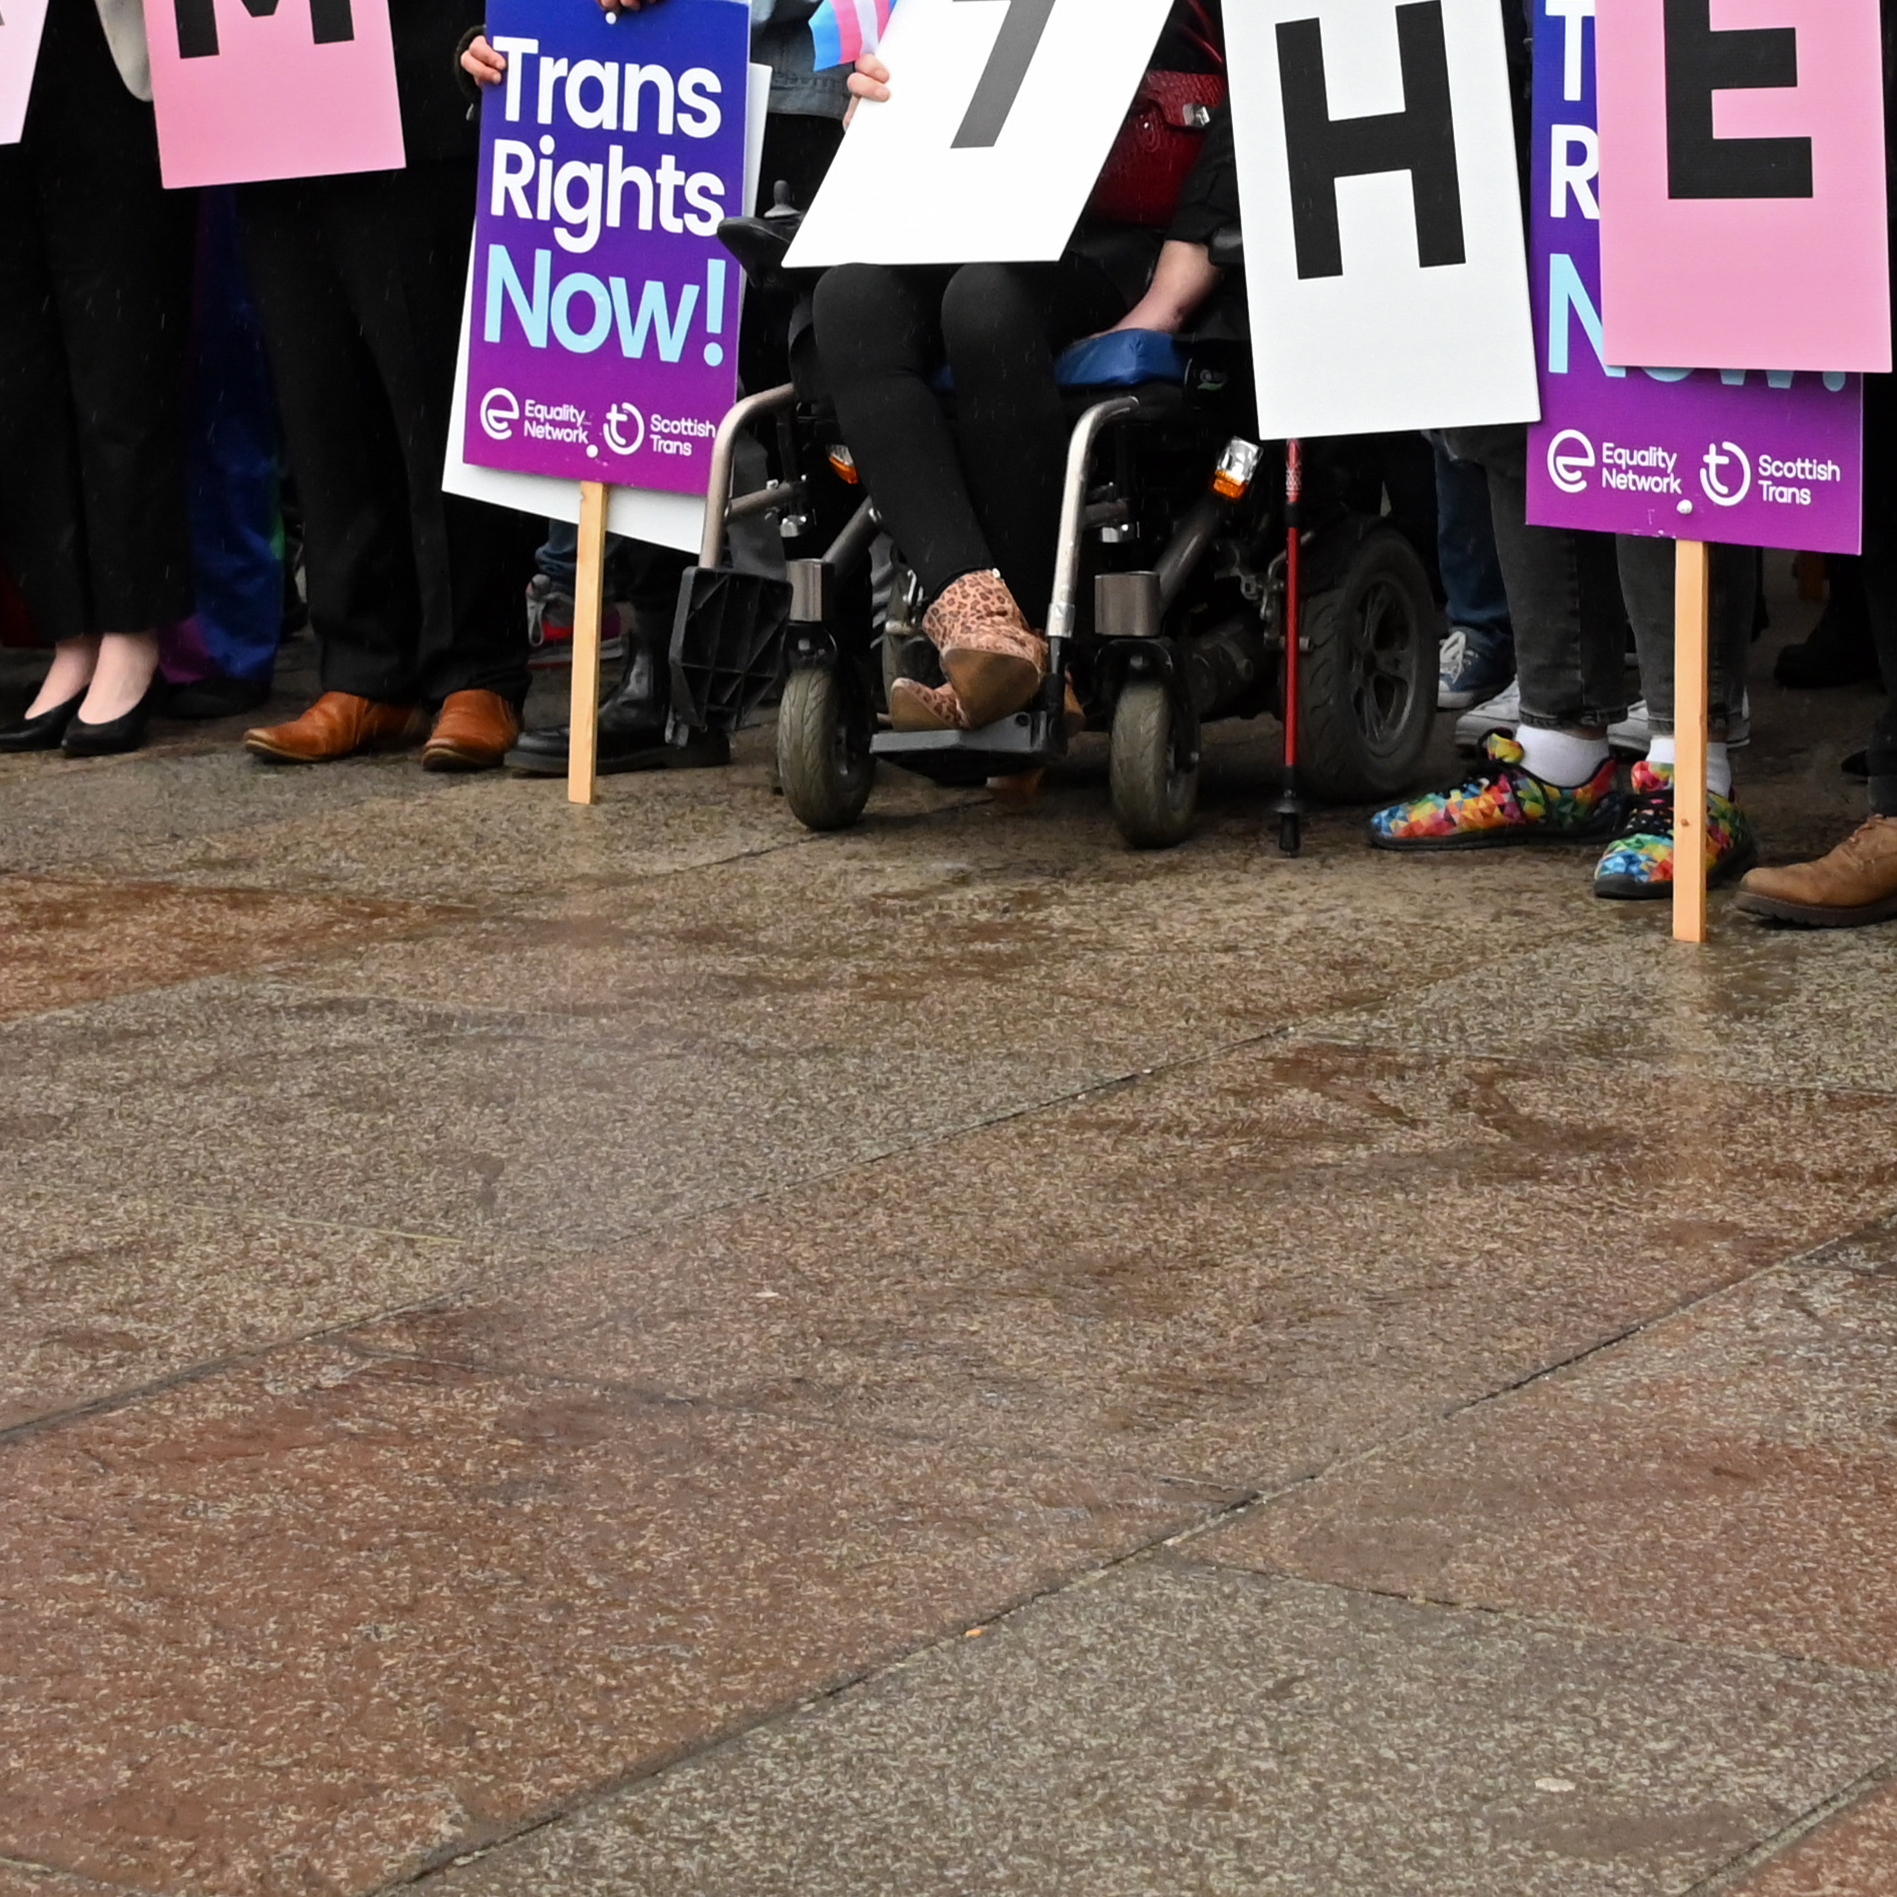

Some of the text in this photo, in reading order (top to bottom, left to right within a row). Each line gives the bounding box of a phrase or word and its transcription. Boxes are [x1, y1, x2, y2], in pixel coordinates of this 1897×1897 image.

[493, 36, 722, 138] Trans
[1275, 0, 1466, 280] H
[490, 134, 725, 253] Rights
[484, 244, 727, 367] Now!
[524, 399, 585, 425] Equality
[650, 413, 715, 438] Scottish
[523, 421, 589, 444] Network
[650, 434, 692, 456] Trans
[1602, 443, 1677, 470] Equality
[1758, 454, 1841, 484] Scottish
[1602, 466, 1682, 494] Network
[1758, 480, 1811, 506] Trans
